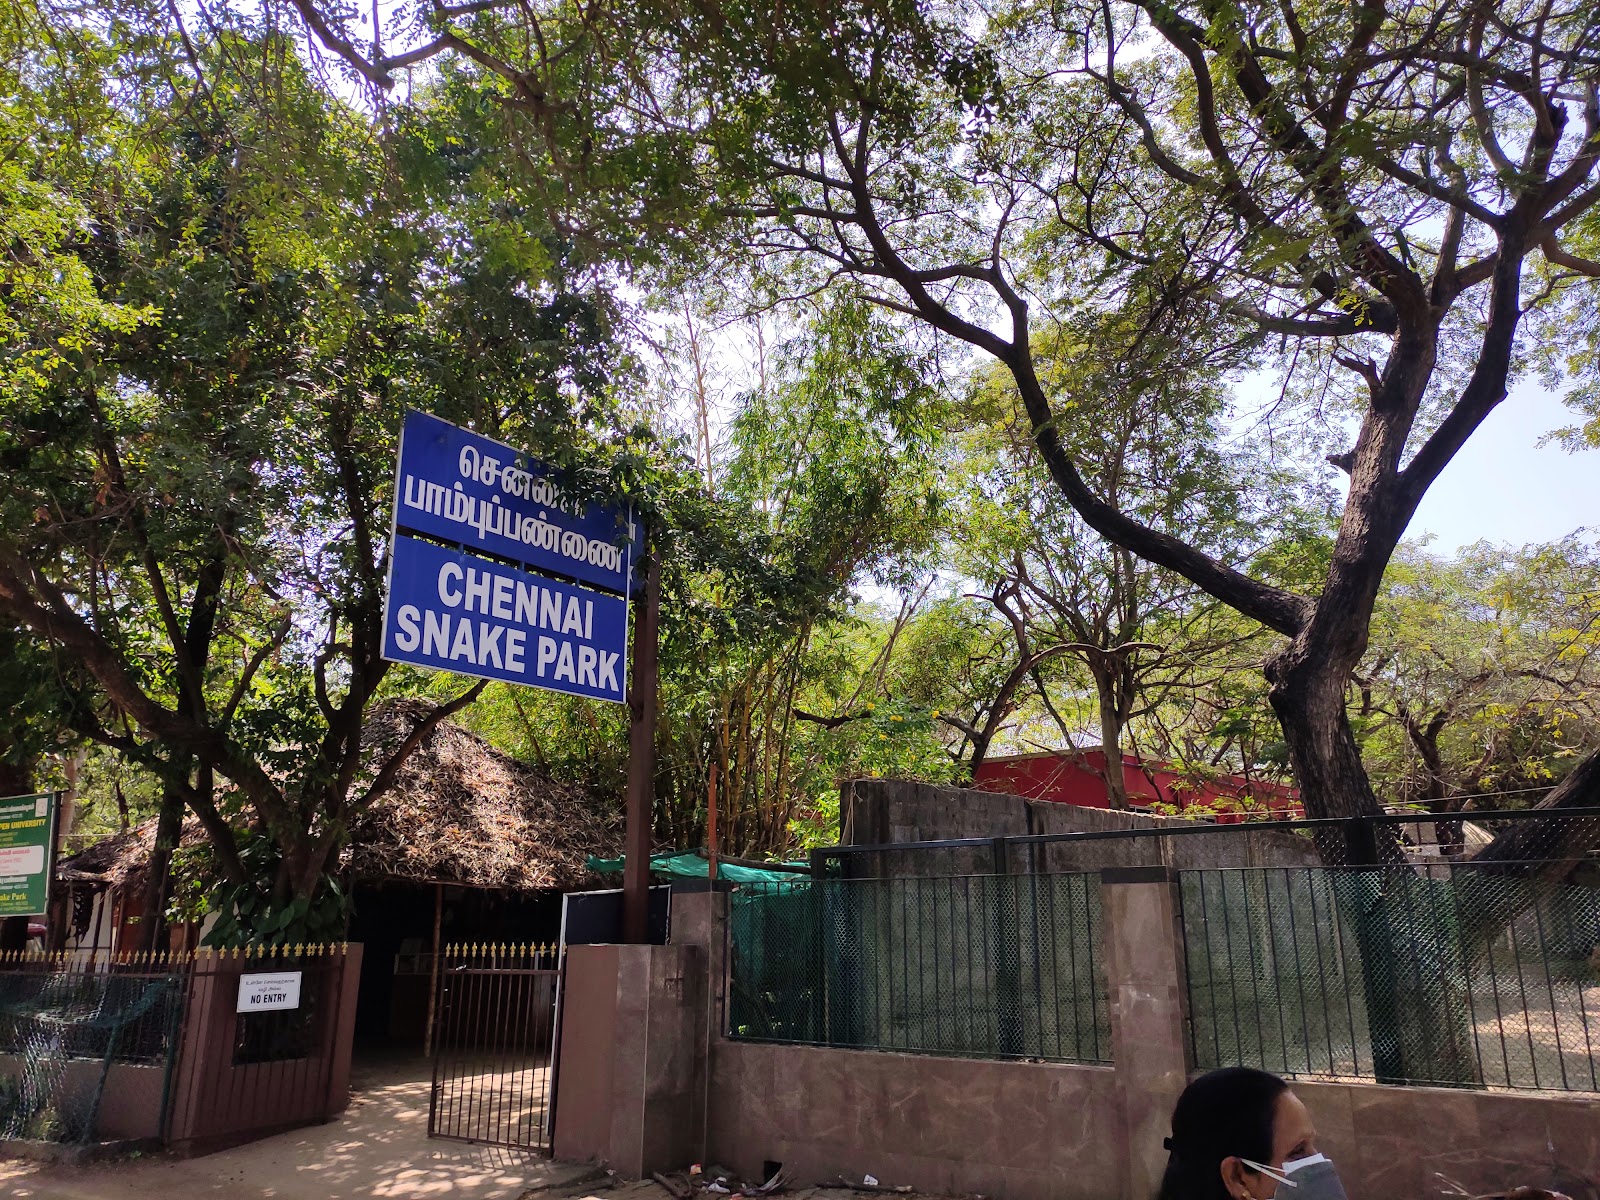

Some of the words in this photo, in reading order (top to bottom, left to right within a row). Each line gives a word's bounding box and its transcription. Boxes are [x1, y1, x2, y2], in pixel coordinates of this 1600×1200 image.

[404, 474, 623, 573] பாம்புப்பண்ணை
[438, 562, 593, 640] CHENNAI
[394, 604, 527, 673] SNAKE
[536, 636, 620, 692] PARK
[11, 819, 46, 829] UNIVERSITY
[12, 893, 27, 901] Park
[251, 995, 261, 1004] NO
[263, 993, 287, 1003] ENTRY
